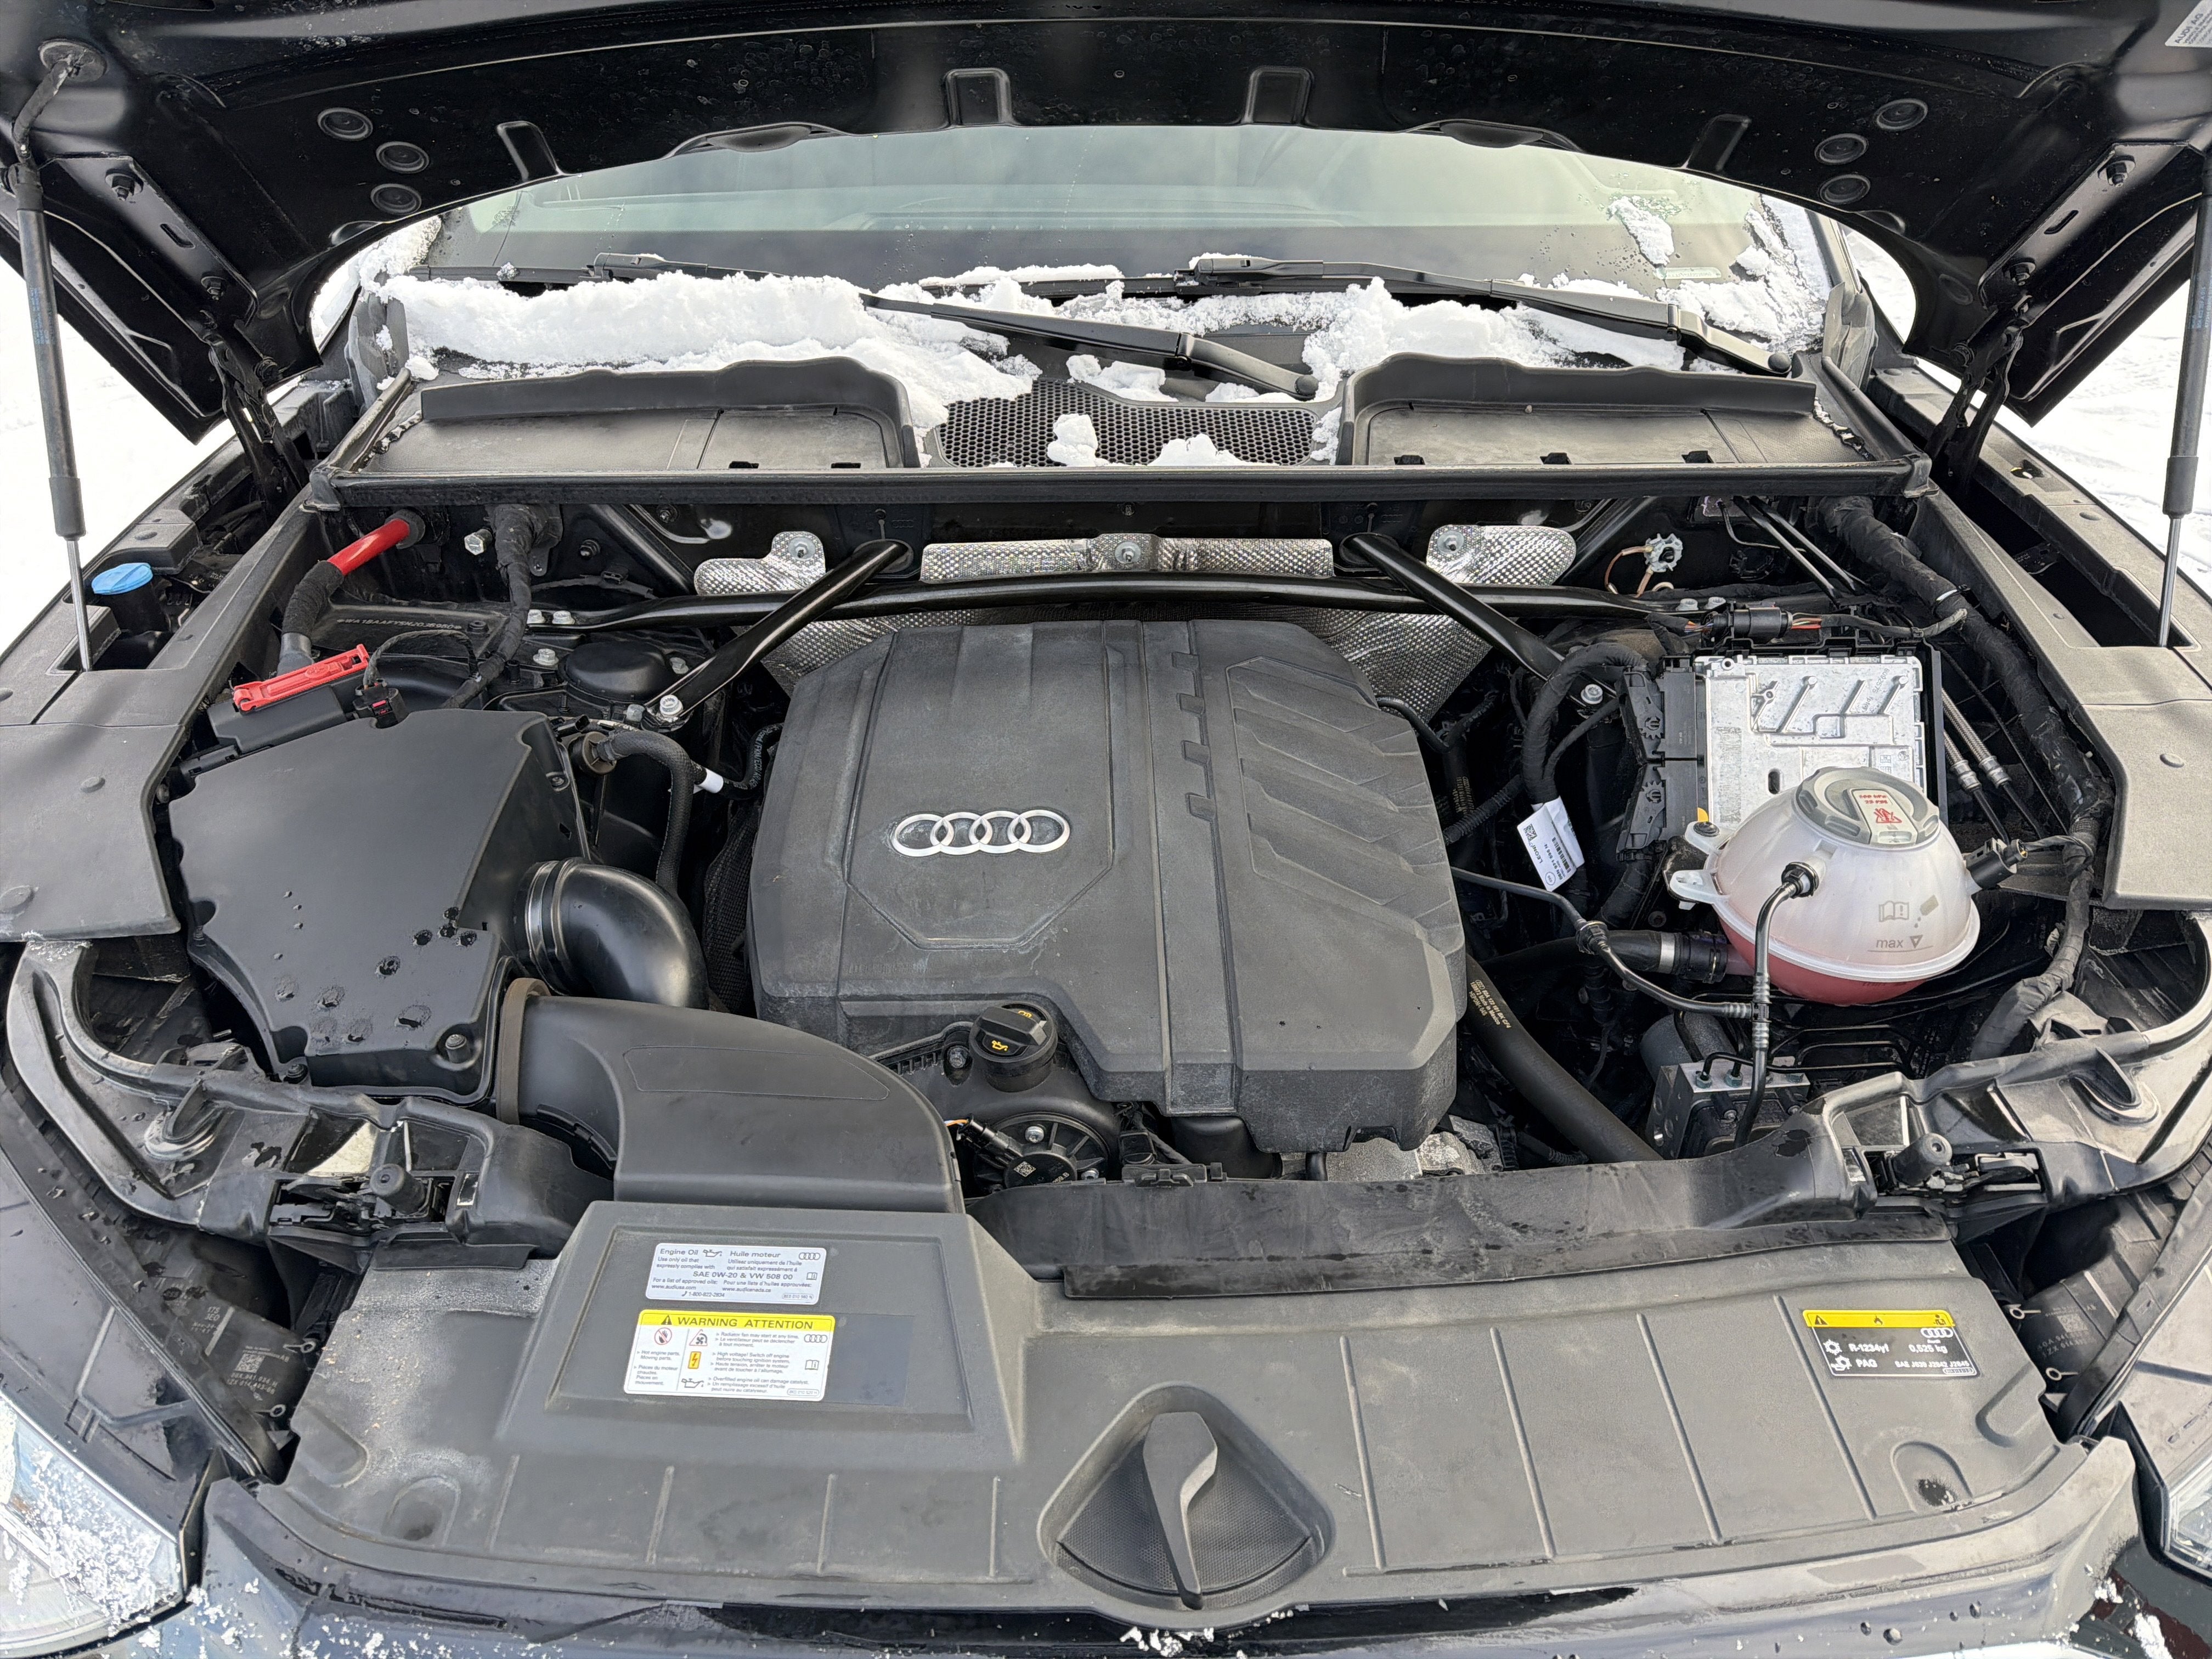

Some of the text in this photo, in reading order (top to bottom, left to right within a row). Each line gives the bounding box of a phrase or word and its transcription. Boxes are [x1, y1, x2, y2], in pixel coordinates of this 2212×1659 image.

[2175, 26, 2193, 43] AUDI
[2191, 14, 2203, 25] AG
[1532, 845, 1543, 864] LEONI
[1876, 940, 1903, 948] max
[1479, 995, 1488, 1006] Made
[1488, 1010, 1500, 1025] Mexico
[678, 1317, 813, 1329] WARNING ATTENTION
[1848, 1343, 1889, 1353] R-1234yf
[1936, 1344, 1948, 1354] kg
[1856, 1359, 1877, 1368] PAG
